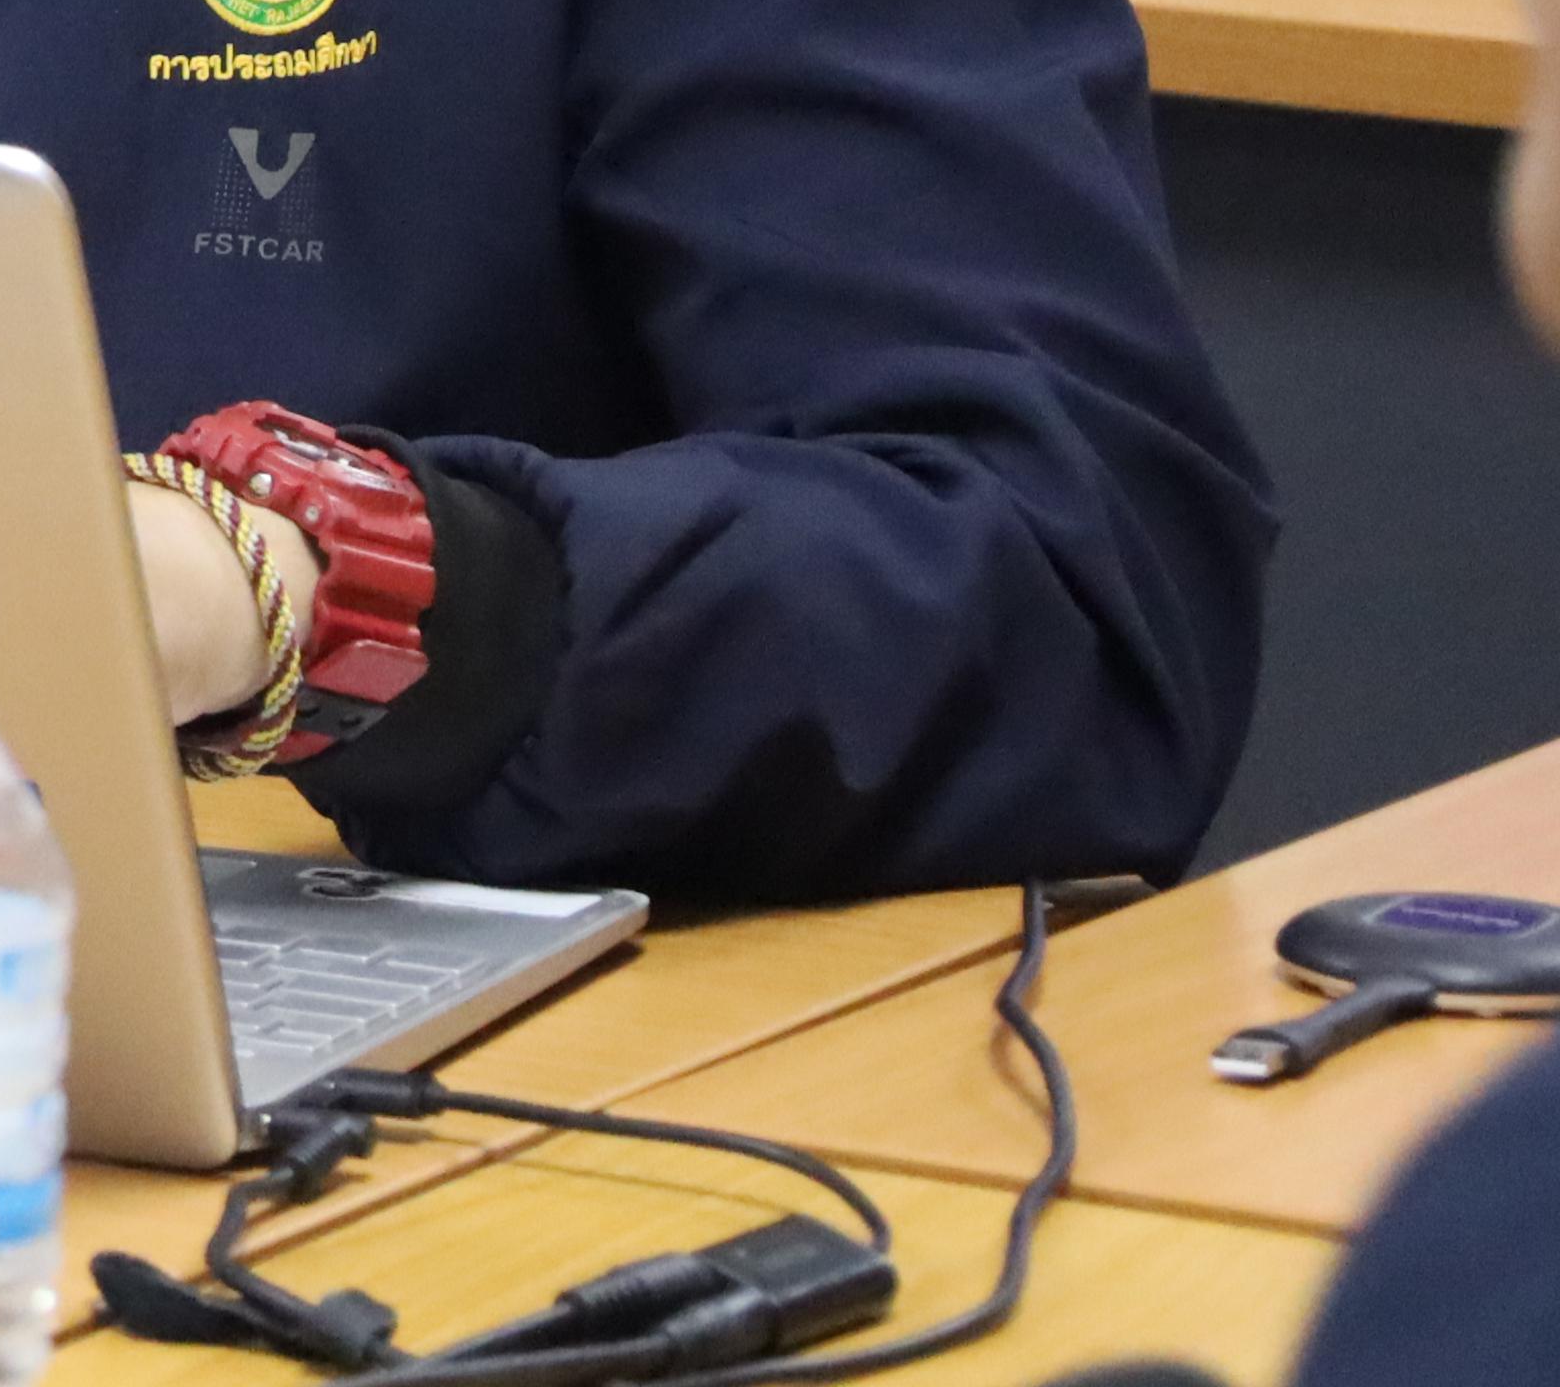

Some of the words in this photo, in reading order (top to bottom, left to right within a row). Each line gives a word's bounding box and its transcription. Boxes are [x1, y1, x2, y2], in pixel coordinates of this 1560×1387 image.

[149, 29, 377, 82] การประถมศึกษา
[194, 232, 324, 263] FSTCAR
